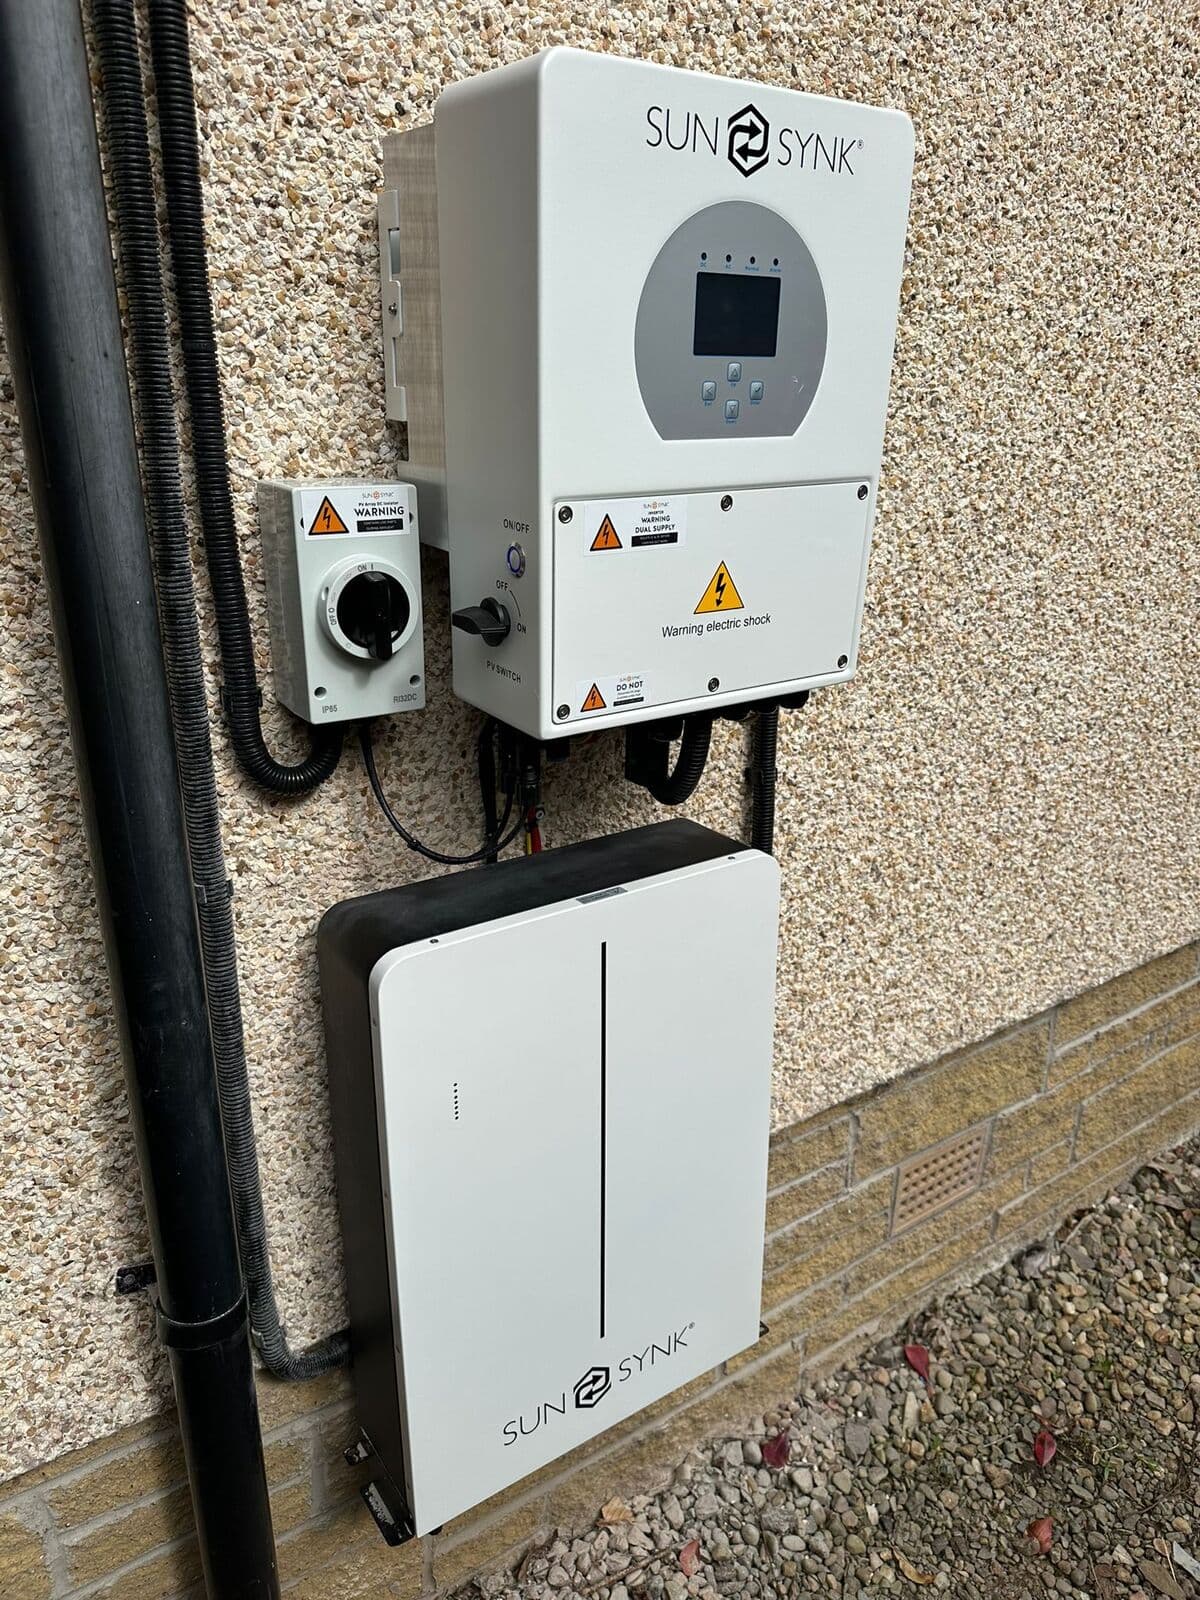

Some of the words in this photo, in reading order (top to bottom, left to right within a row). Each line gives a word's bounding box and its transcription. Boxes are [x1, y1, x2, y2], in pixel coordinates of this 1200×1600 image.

[646, 105, 719, 156] SUN
[353, 505, 405, 517] WARNING
[641, 514, 671, 523] WARNING
[503, 518, 530, 534] ON/OFF
[635, 526, 652, 534] DUAL
[653, 523, 676, 532] SUPPLY
[357, 563, 367, 572] ON
[496, 579, 509, 591] OFF
[517, 622, 527, 634] ON
[661, 624, 704, 638] Warning
[706, 618, 742, 632] electric
[743, 613, 771, 627] shock
[495, 664, 522, 684] SWITCH
[616, 683, 628, 692] DO
[629, 680, 643, 690] NOT
[321, 704, 338, 714] IP65
[502, 1392, 566, 1446] SUN
